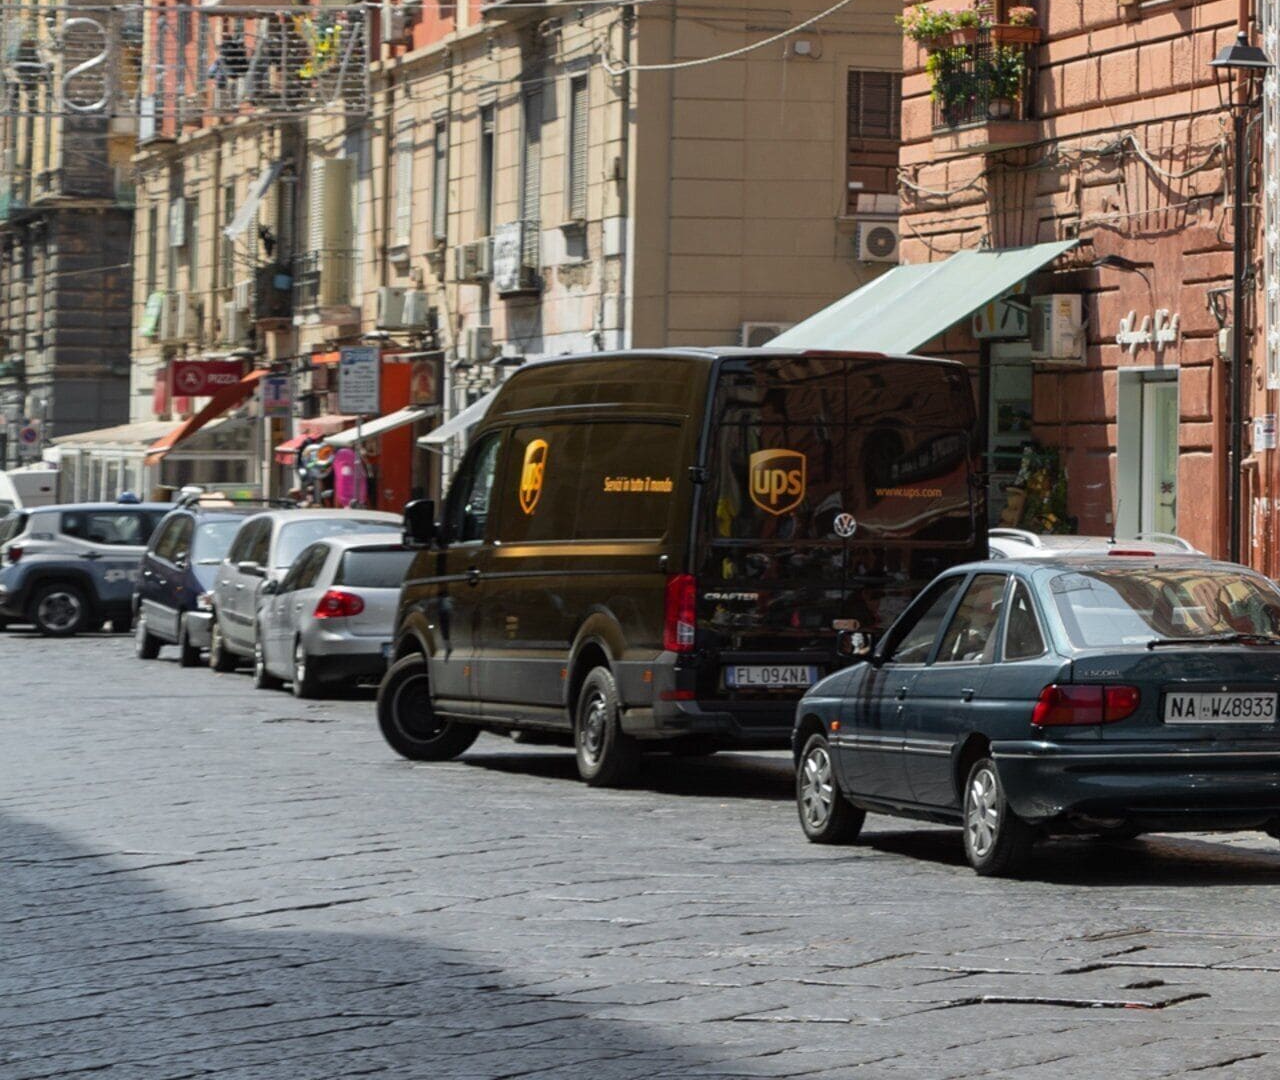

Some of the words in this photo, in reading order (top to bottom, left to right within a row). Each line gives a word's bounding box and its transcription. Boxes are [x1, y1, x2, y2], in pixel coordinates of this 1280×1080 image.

[754, 469, 800, 505] ups
[875, 486, 942, 499] www.ups.com
[704, 592, 760, 601] CRAFTER
